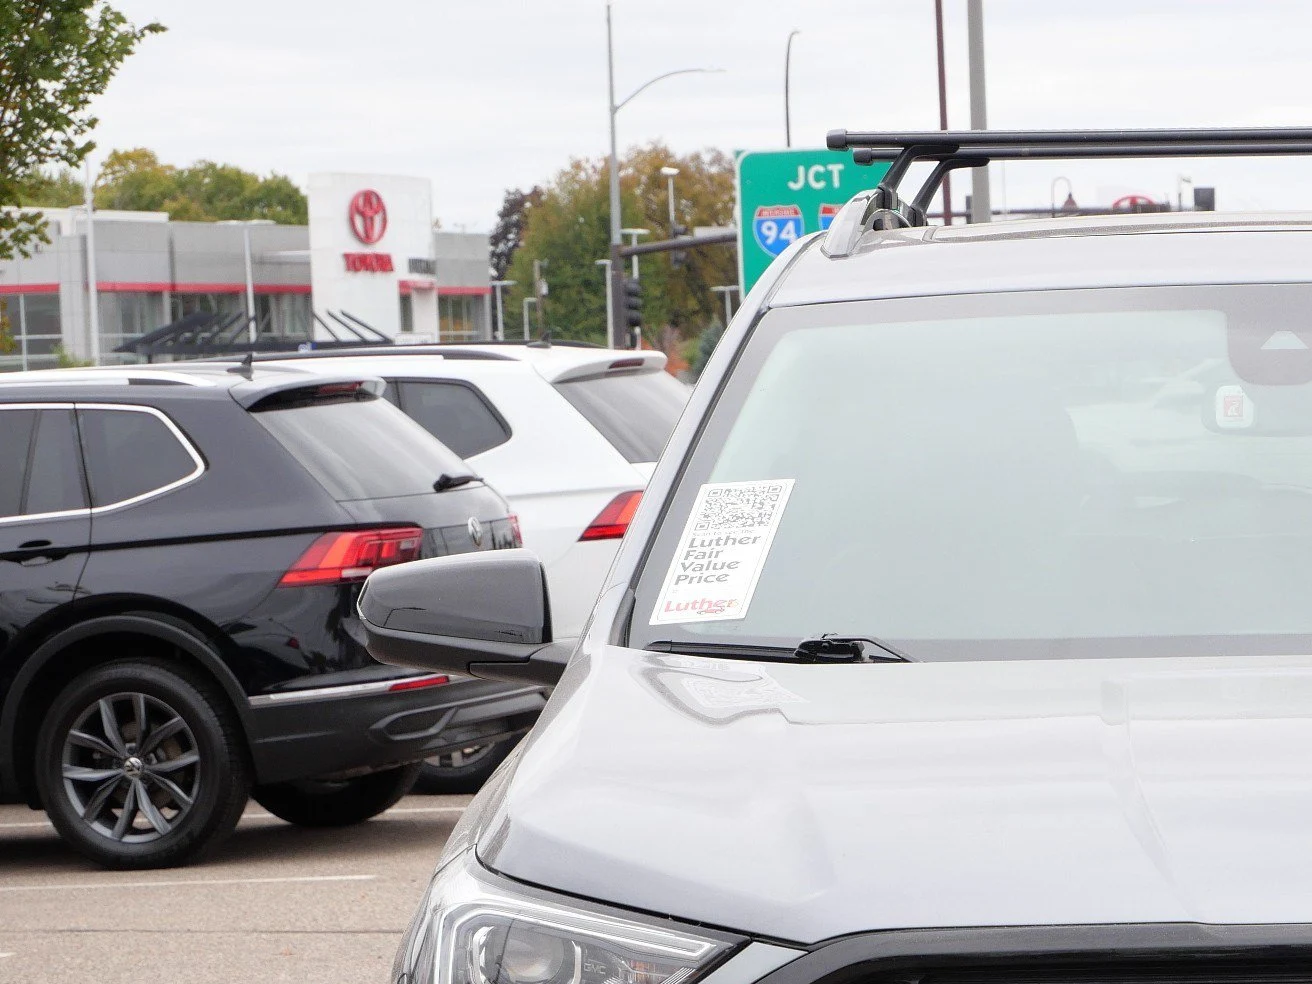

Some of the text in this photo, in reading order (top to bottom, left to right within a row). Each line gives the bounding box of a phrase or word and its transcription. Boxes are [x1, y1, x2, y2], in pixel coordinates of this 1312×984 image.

[787, 163, 845, 190] JCT
[761, 220, 798, 245] 94
[688, 535, 762, 549] Luther
[683, 548, 724, 561] Fair
[680, 560, 741, 572] Value
[674, 573, 730, 586] Price
[664, 598, 737, 613] Luther
